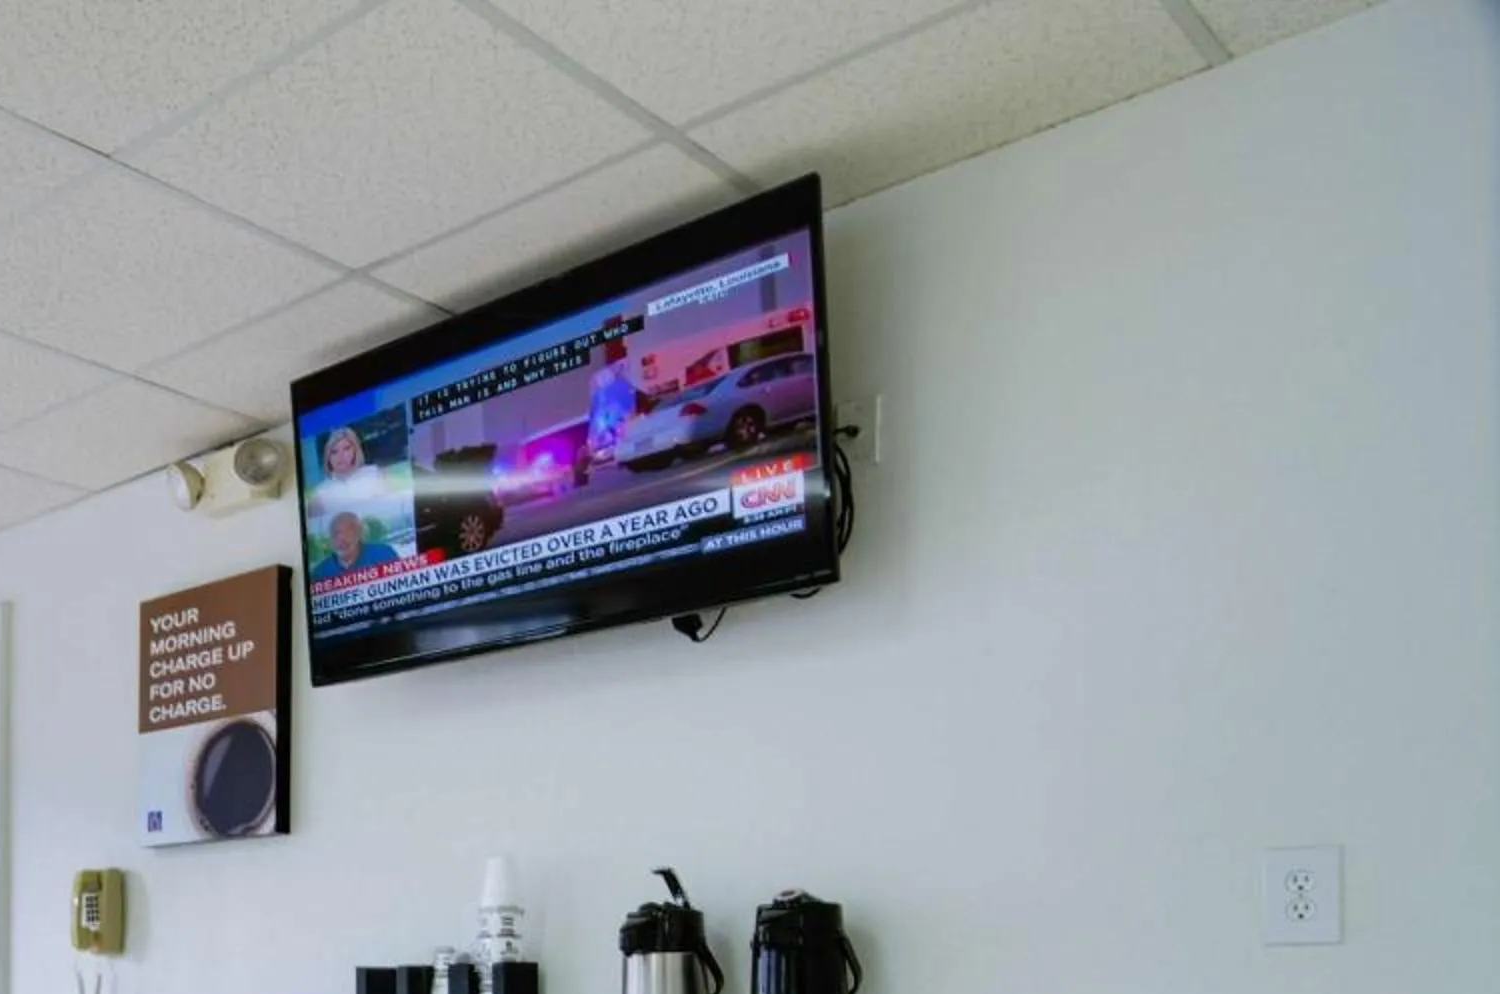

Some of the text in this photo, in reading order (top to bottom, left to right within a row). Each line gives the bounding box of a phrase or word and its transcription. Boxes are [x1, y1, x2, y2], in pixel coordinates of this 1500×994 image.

[523, 345, 566, 369] FIGURE
[741, 459, 792, 482] LIVE
[741, 480, 796, 509] CNN
[367, 571, 430, 597] GUNMAN
[434, 560, 471, 581] WAS
[475, 543, 542, 571] EVICTED
[547, 529, 595, 551] OVER
[601, 525, 613, 540] A
[618, 509, 669, 534] YEAR
[674, 497, 719, 521] AGO
[372, 586, 442, 612] something
[443, 582, 458, 595] to
[461, 576, 486, 590] the
[487, 568, 513, 585] gas
[516, 561, 542, 577] line
[546, 553, 575, 570] and
[579, 545, 605, 561] the
[382, 553, 429, 575] NEWS
[150, 607, 199, 634] YOUR
[150, 621, 236, 656] MORNING
[149, 640, 255, 678] CHARGE UP
[149, 672, 216, 701] FOR NO
[149, 694, 227, 723] CHARGE.
